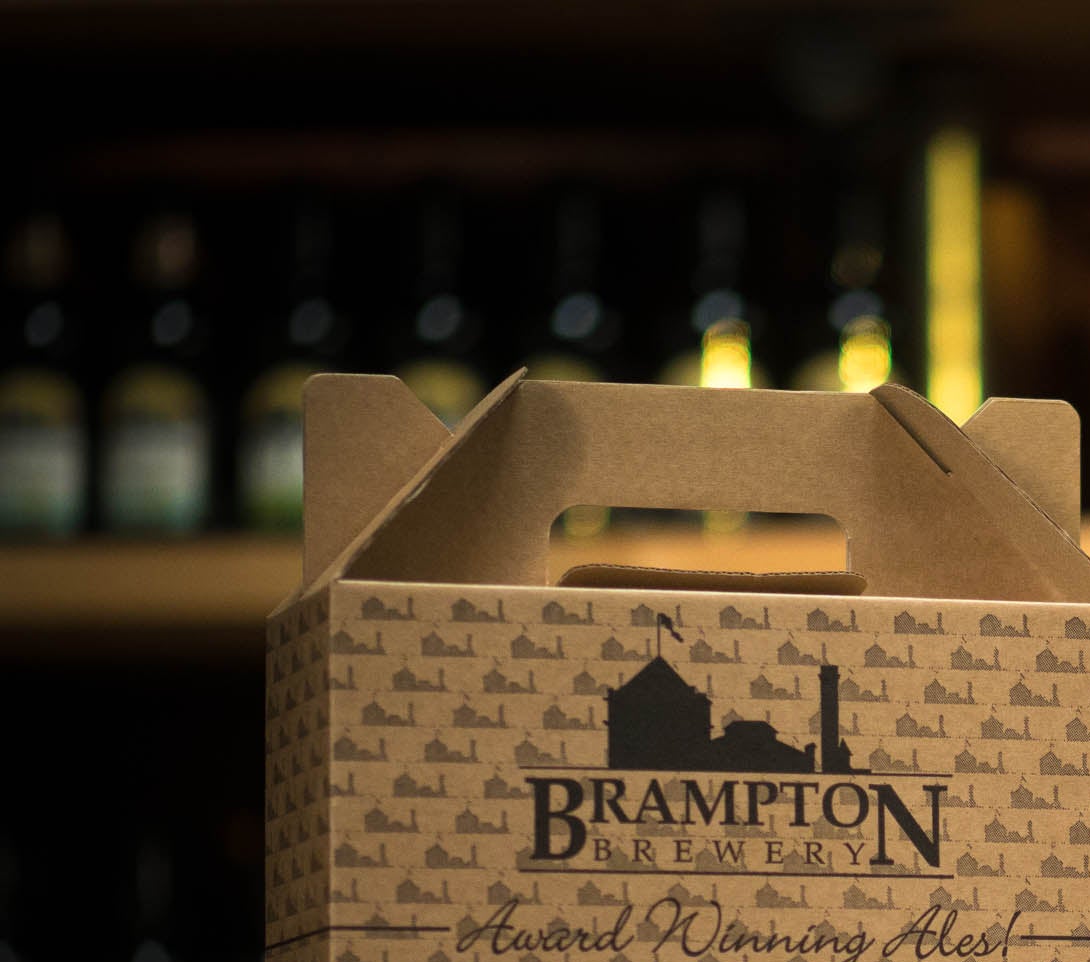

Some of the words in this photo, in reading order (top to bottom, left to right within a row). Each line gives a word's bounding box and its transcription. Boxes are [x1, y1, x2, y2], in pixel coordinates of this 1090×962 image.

[525, 776, 948, 868] BRAMPTON
[592, 838, 867, 866] BREWERY
[455, 898, 635, 955] Award
[882, 904, 1022, 959] Ales!
